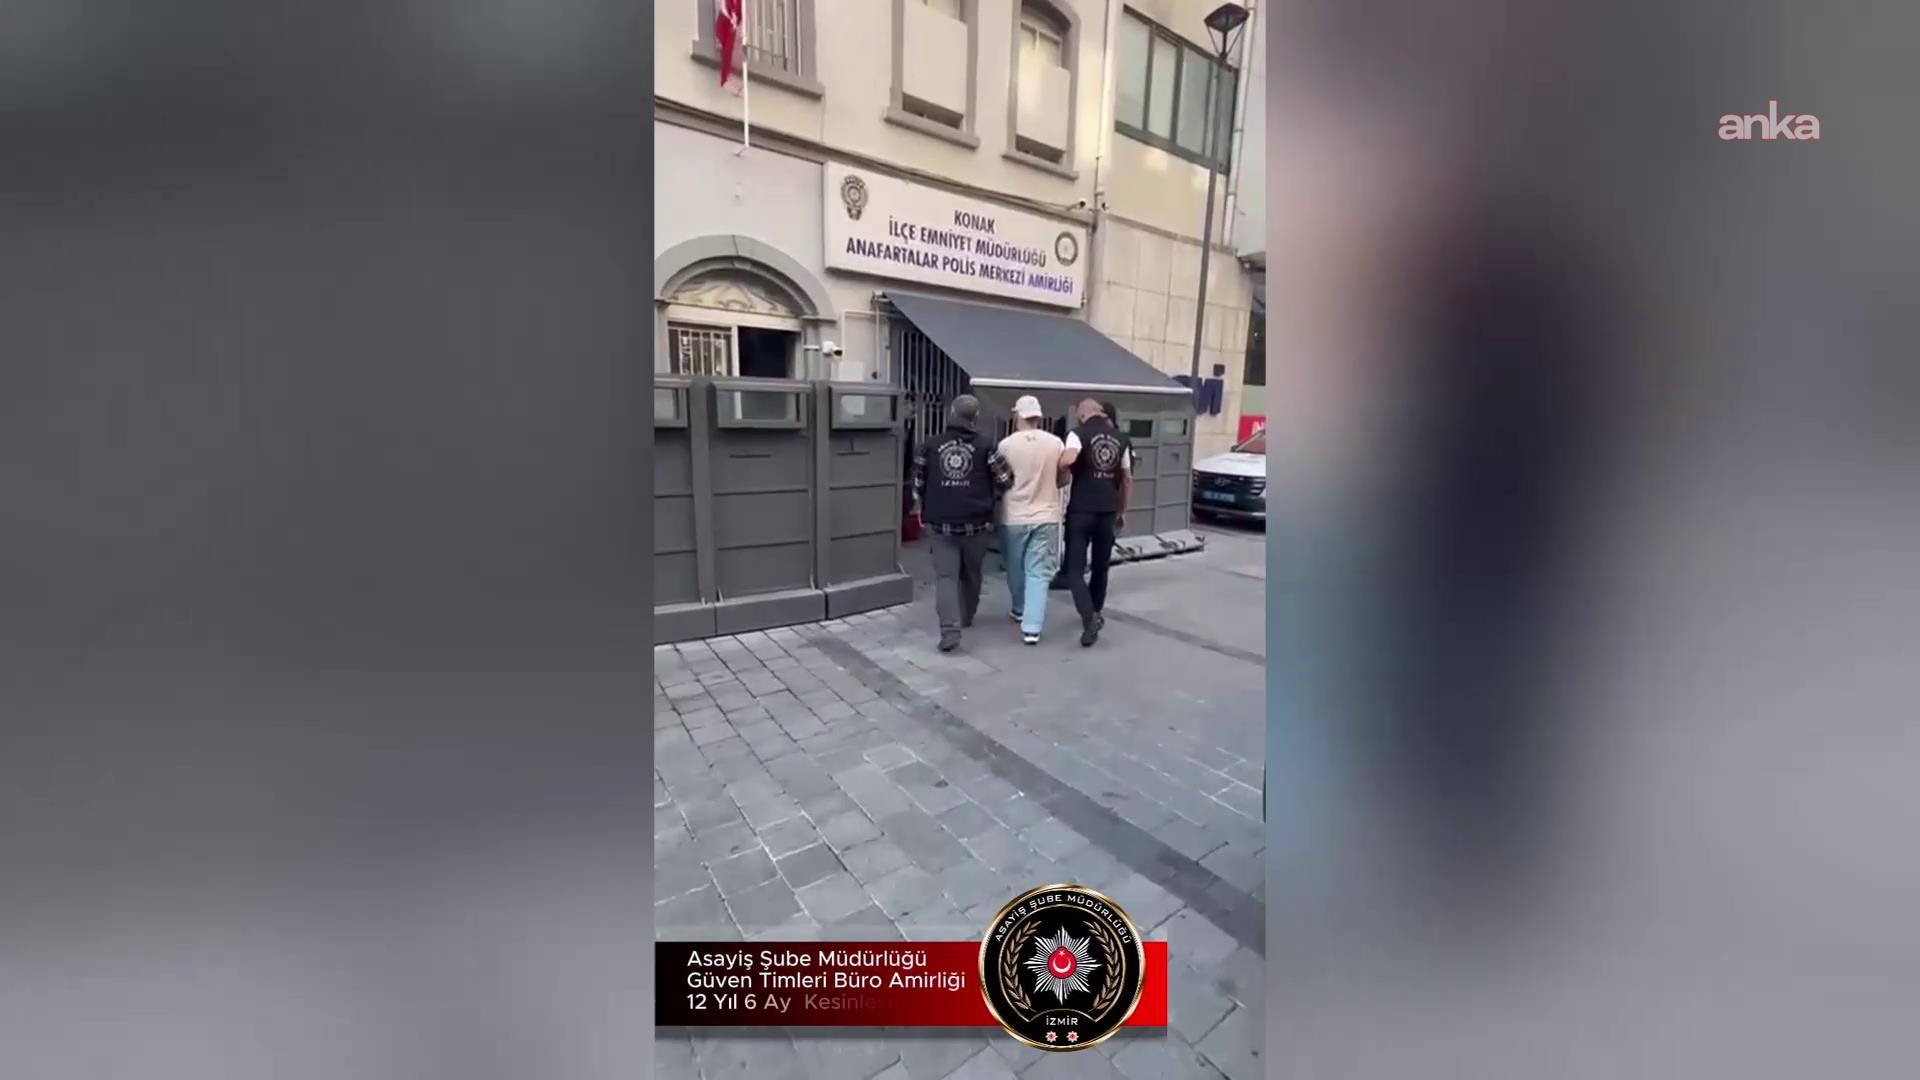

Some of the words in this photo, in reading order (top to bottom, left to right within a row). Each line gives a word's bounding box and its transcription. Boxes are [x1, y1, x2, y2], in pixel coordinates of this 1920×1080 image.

[888, 215, 916, 244] İLÇE
[920, 227, 972, 252] EMNİYET
[975, 238, 1046, 267] MÜDÜRLÜĞÜ
[954, 210, 995, 234] KONAK
[846, 237, 938, 270] ANAFARTALAR
[942, 256, 976, 276] POLİS
[979, 264, 1025, 286] MERKEZİ
[1028, 274, 1073, 294] AMİRLİĞİ
